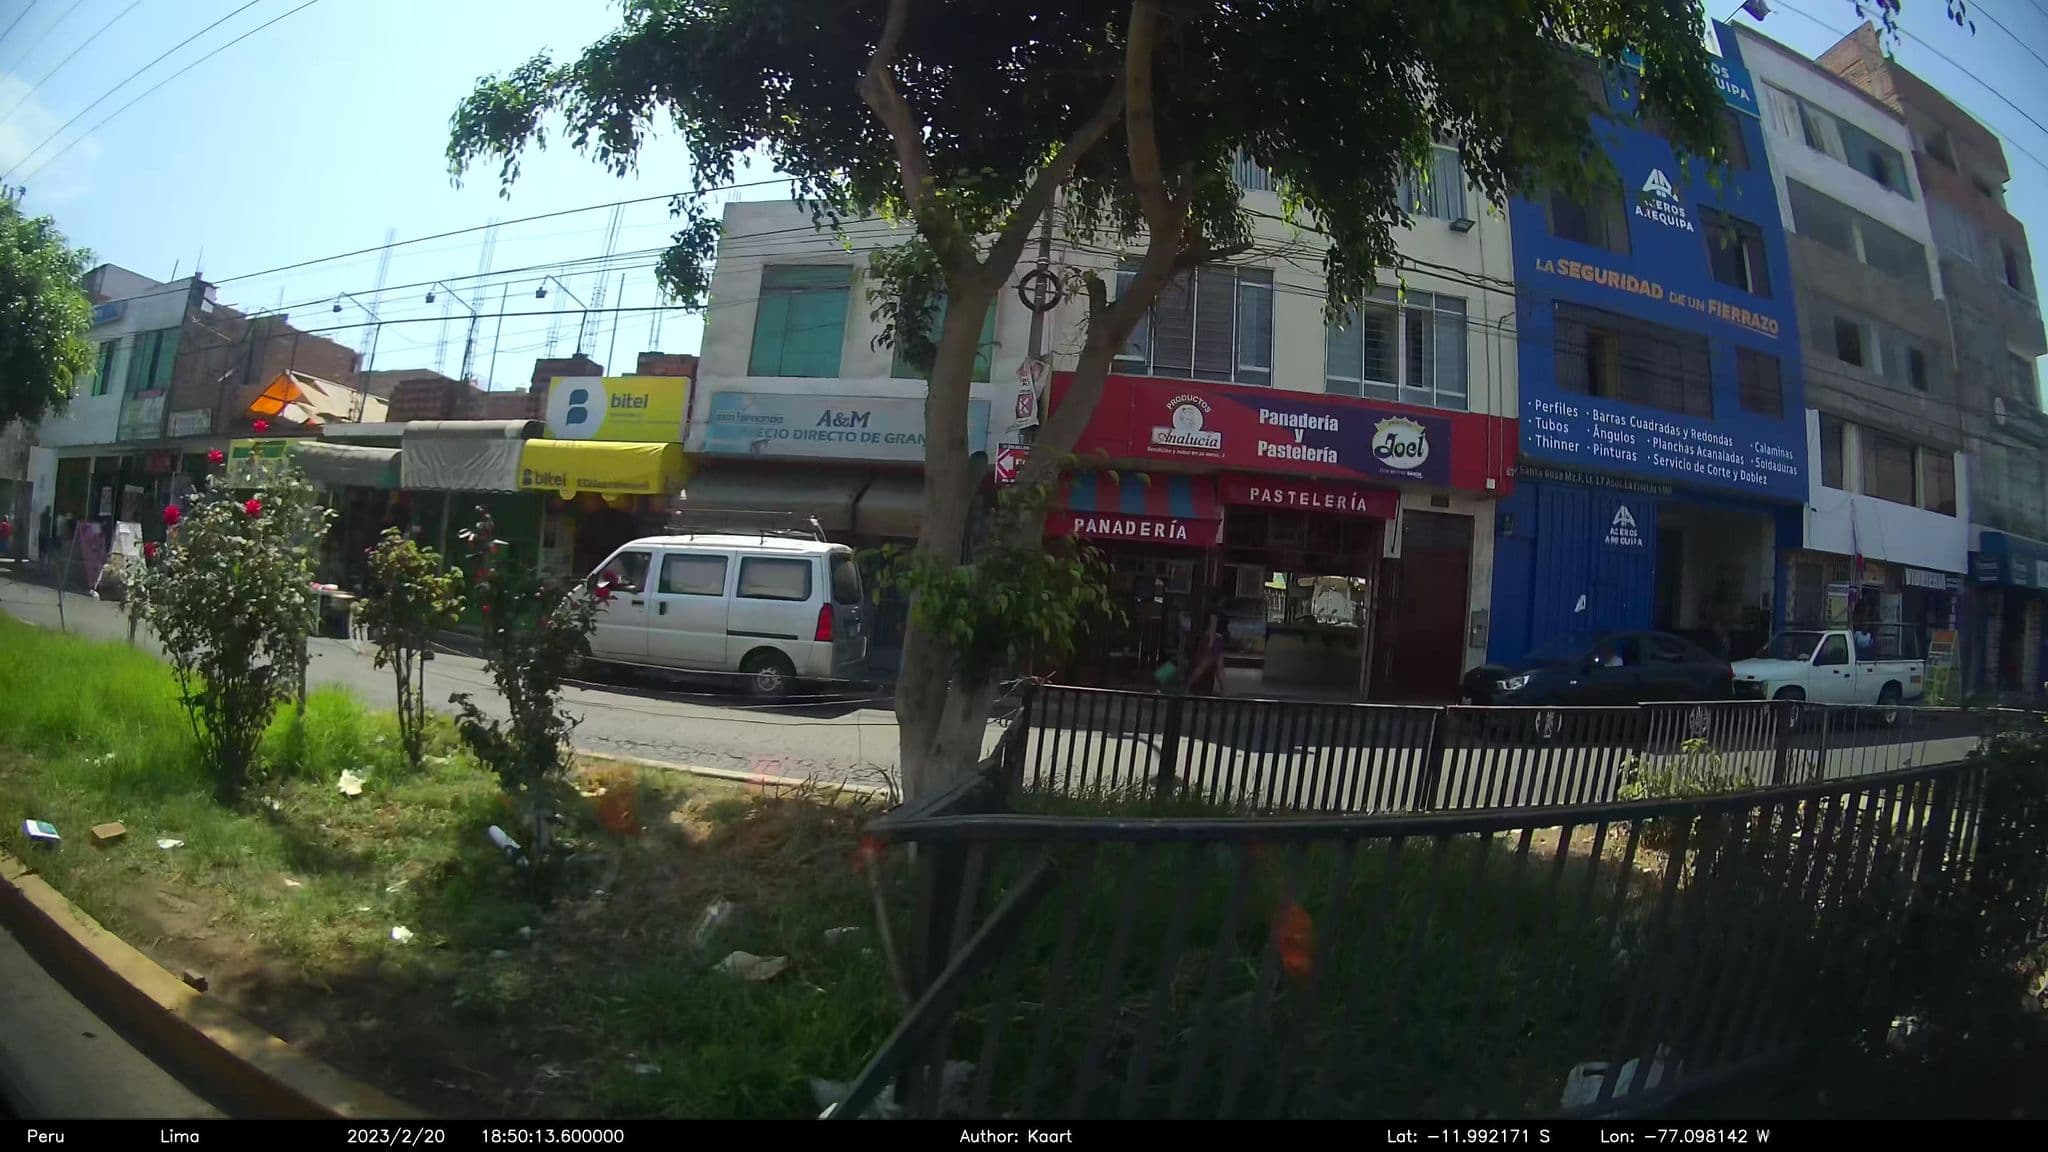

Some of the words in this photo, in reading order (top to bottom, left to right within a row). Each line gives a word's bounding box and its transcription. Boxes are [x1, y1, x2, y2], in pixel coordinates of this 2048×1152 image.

[1714, 77, 1751, 102] UIPA
[1535, 258, 1555, 274] LA
[1557, 258, 1664, 300] SEGURIDAD
[1669, 290, 1686, 306] DE
[1688, 298, 1705, 313] UN
[1708, 298, 1779, 334] FIERRAZO
[610, 393, 649, 409] bitel
[1166, 394, 1213, 414] PRODUCTOS
[1535, 399, 1579, 418] Perfiles
[816, 409, 871, 429] A&M
[1259, 408, 1339, 433] Panadería
[1535, 416, 1570, 434] Tubos
[1593, 408, 1627, 426] Barras
[1630, 416, 1681, 437] Cuadradas
[1682, 425, 1689, 440] y
[1691, 427, 1734, 448] Redondas
[793, 429, 858, 443] DIRECTO
[860, 431, 881, 444] DE
[1293, 428, 1305, 443] y
[1374, 431, 1426, 460] Joel
[1535, 434, 1580, 453] Thinner
[1593, 424, 1637, 446] Ángulos
[1257, 440, 1339, 464] Pastelería
[1593, 443, 1638, 463] Pinturas
[1652, 437, 1695, 457] Planchas
[1696, 445, 1745, 466] Acanaladas
[1754, 441, 1794, 460] Calaminas
[1653, 452, 1693, 472] Servicio
[1694, 458, 1706, 474] de
[1707, 462, 1732, 479] Corte
[1732, 468, 1740, 483] y
[1740, 469, 1769, 486] Doblez
[1755, 457, 1799, 476] Soldaduras
[1249, 486, 1368, 513] PASTELERÍA
[1073, 517, 1188, 541] PANADERÍA
